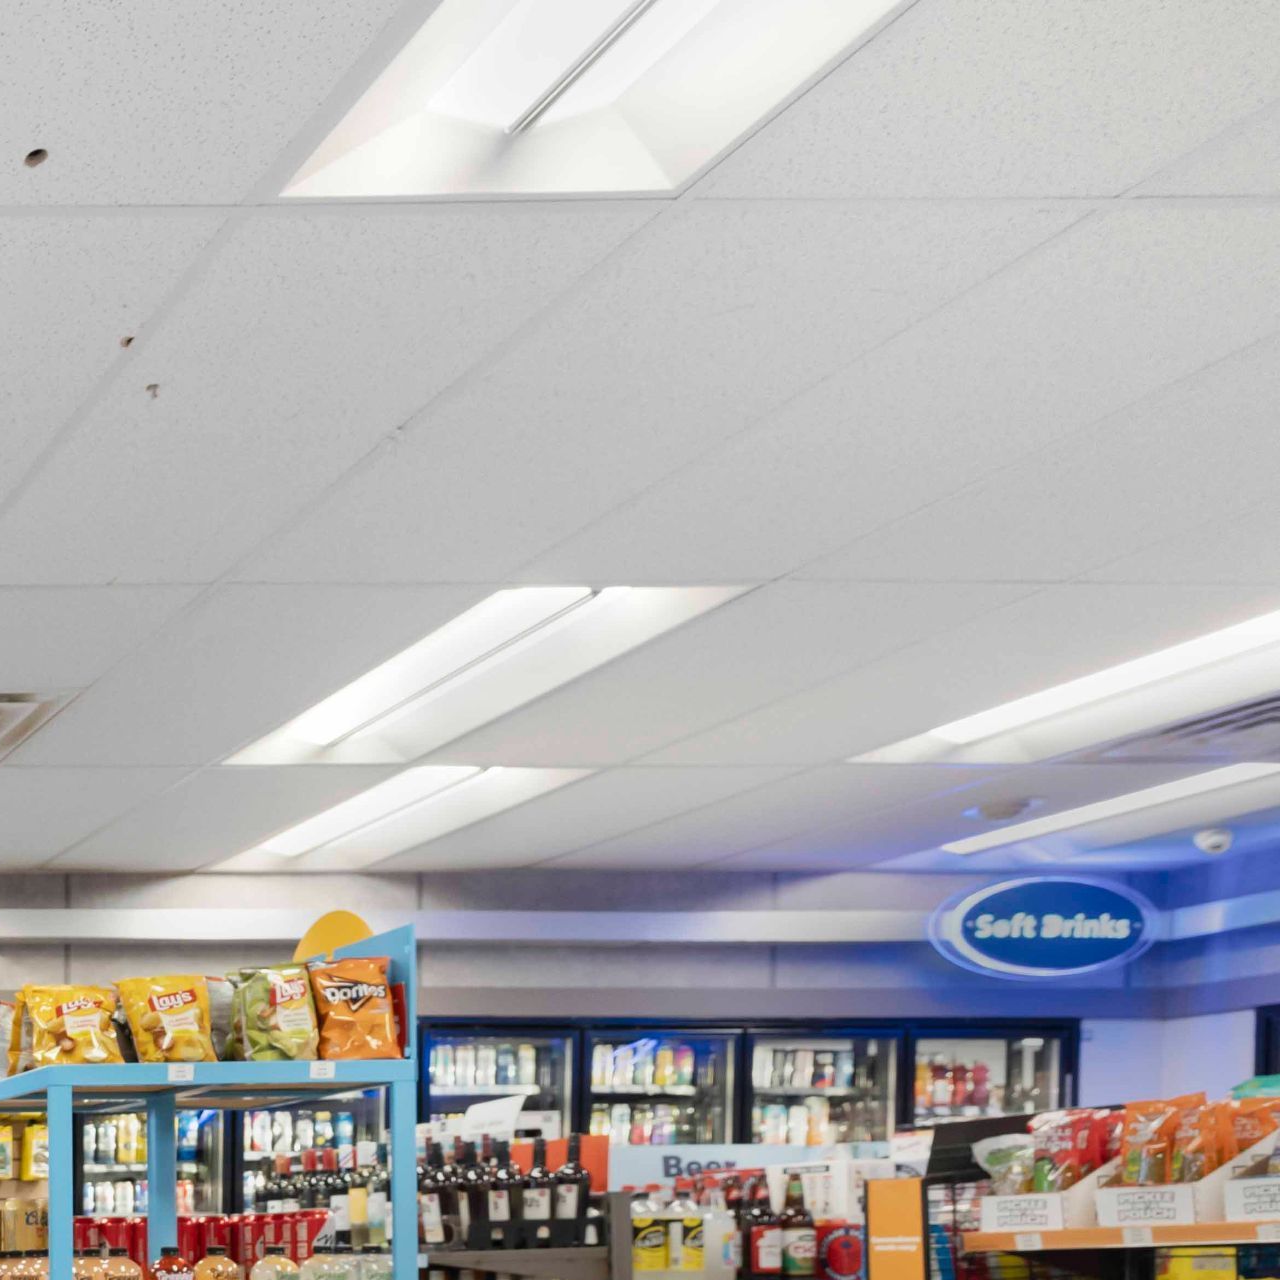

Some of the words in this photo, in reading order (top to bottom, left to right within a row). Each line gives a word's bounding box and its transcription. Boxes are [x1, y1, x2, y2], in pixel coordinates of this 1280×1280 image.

[975, 914, 1036, 938] Soft
[1041, 915, 1129, 939] Drinks
[325, 983, 386, 1002] Doritos
